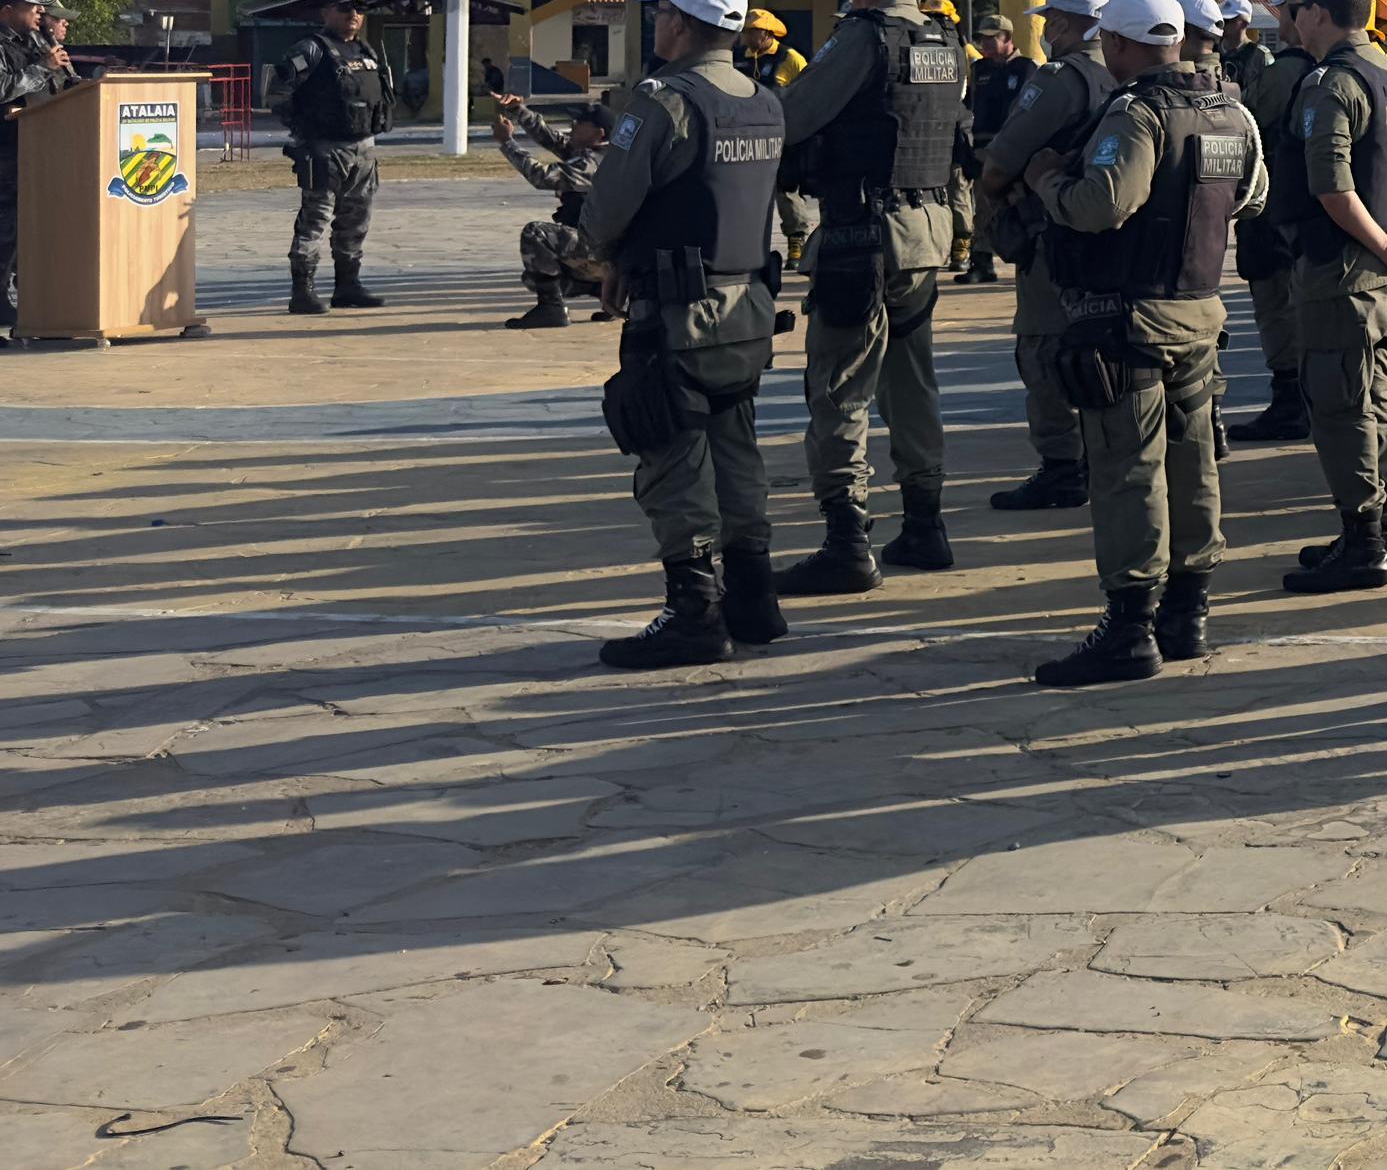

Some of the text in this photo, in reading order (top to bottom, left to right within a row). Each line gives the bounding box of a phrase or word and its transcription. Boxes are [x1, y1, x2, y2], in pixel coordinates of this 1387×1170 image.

[914, 49, 954, 66] POLÍCIA
[915, 66, 954, 80] MILITAR
[122, 105, 175, 117] ATALAIA
[715, 137, 783, 162] POLÍCIA MILITAR
[1203, 158, 1243, 173] MILITAR
